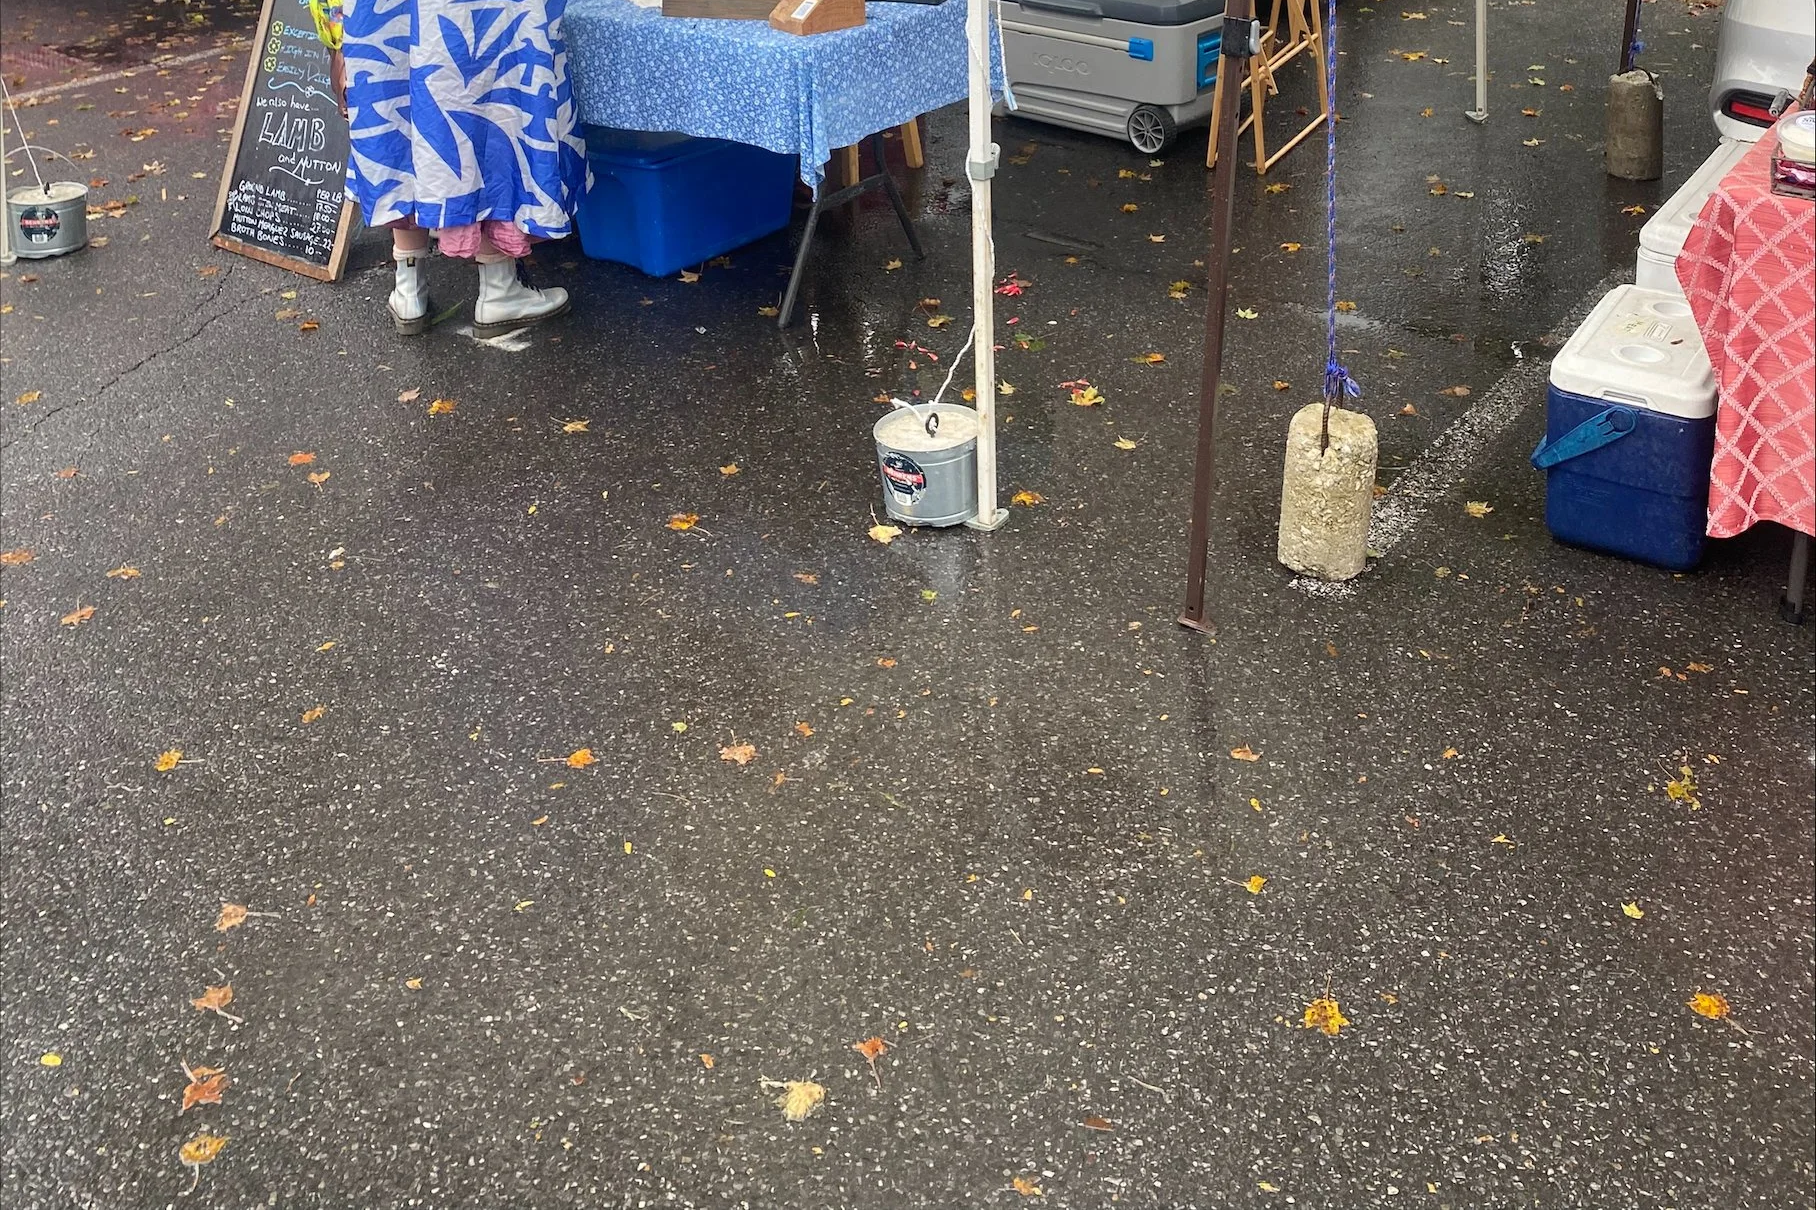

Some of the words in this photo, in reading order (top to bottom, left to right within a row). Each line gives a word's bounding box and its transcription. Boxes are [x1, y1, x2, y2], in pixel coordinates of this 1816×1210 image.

[256, 96, 268, 107] We
[258, 111, 326, 152] LAMB
[278, 151, 296, 165] and
[292, 155, 342, 179] MUTTON
[265, 186, 287, 202] LAMB
[316, 188, 330, 201] PER
[331, 191, 343, 204] LB
[255, 208, 281, 223] CHOPS
[230, 222, 255, 238] BROTH
[256, 230, 285, 247] BONES
[232, 213, 257, 225] MUTTON
[289, 227, 321, 246] SAUSAGE
